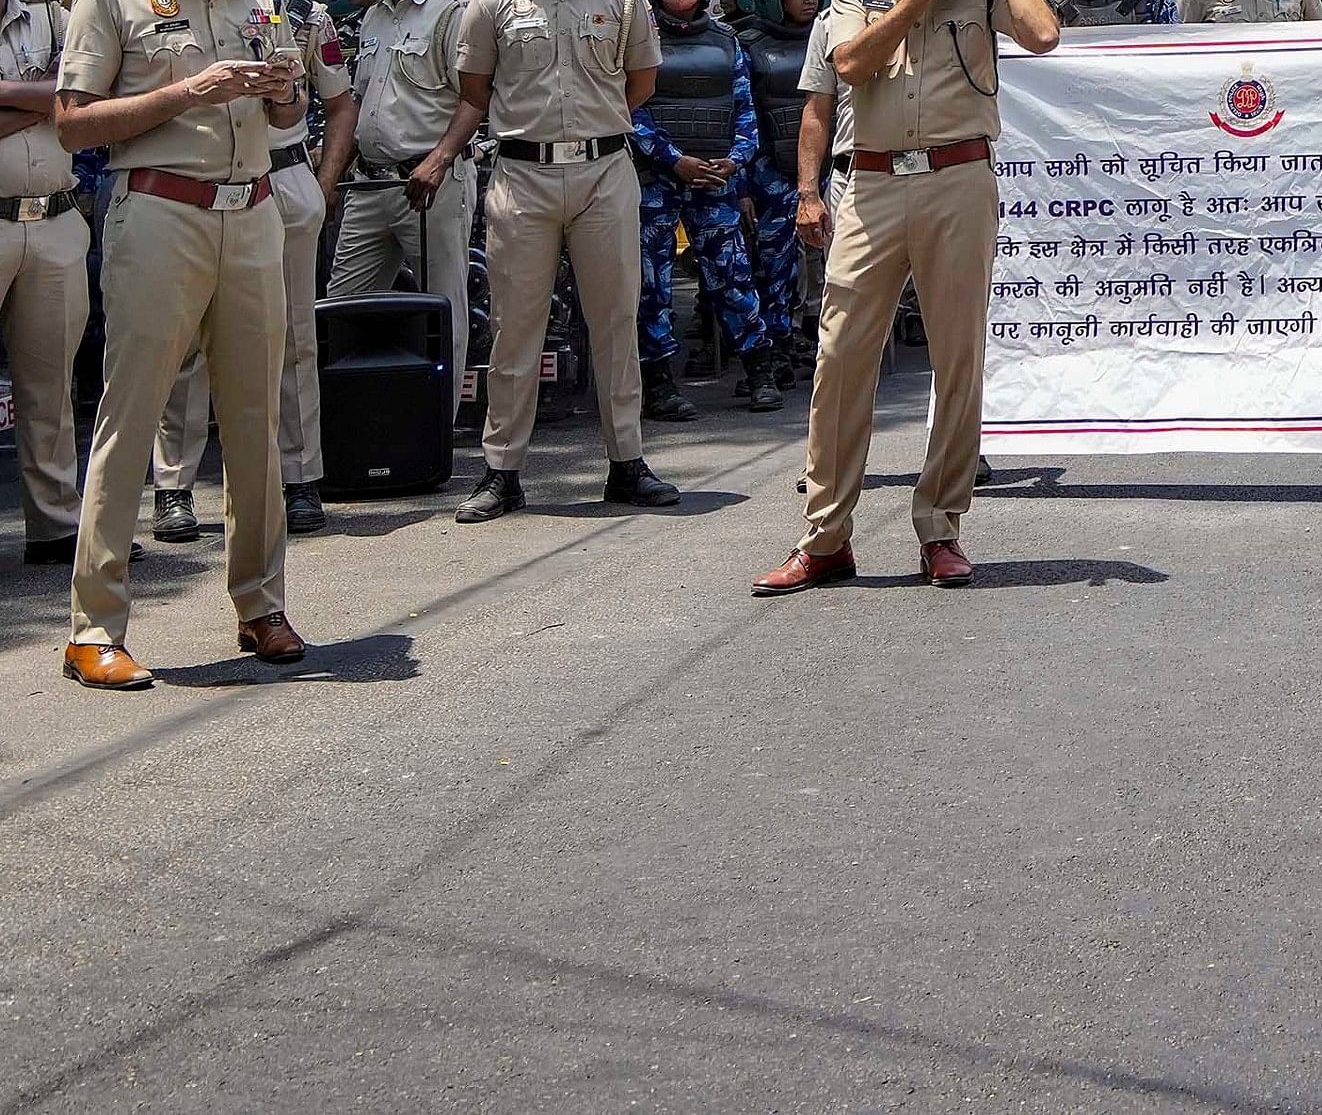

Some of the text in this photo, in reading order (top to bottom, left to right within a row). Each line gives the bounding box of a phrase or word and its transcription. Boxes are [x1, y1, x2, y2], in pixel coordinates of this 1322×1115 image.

[995, 160, 1036, 178] आप
[1045, 152, 1092, 177] सभी
[1101, 153, 1129, 176] को
[1138, 152, 1204, 182] सूचित
[1213, 150, 1270, 174] किया
[999, 200, 1038, 218] 144
[1048, 199, 1116, 219] CRPC
[1124, 199, 1172, 223] लागू
[1178, 191, 1196, 217] है
[1206, 196, 1249, 214] अतः
[1261, 195, 1307, 213] आप
[995, 235, 1022, 258] कि
[1028, 240, 1062, 259] इस
[1070, 234, 1108, 258] क्षेत्र
[1115, 231, 1136, 256] में
[1142, 232, 1199, 257] किसी
[1205, 237, 1252, 256] तरह
[992, 275, 1044, 299] करने
[1055, 273, 1083, 297] की
[1094, 273, 1177, 304] अनुमति
[1186, 271, 1229, 298] नहीं
[990, 322, 1022, 340] पर
[1028, 314, 1103, 345] कानूनी
[1109, 313, 1203, 338] कार्यवाही
[1210, 312, 1240, 336] की
